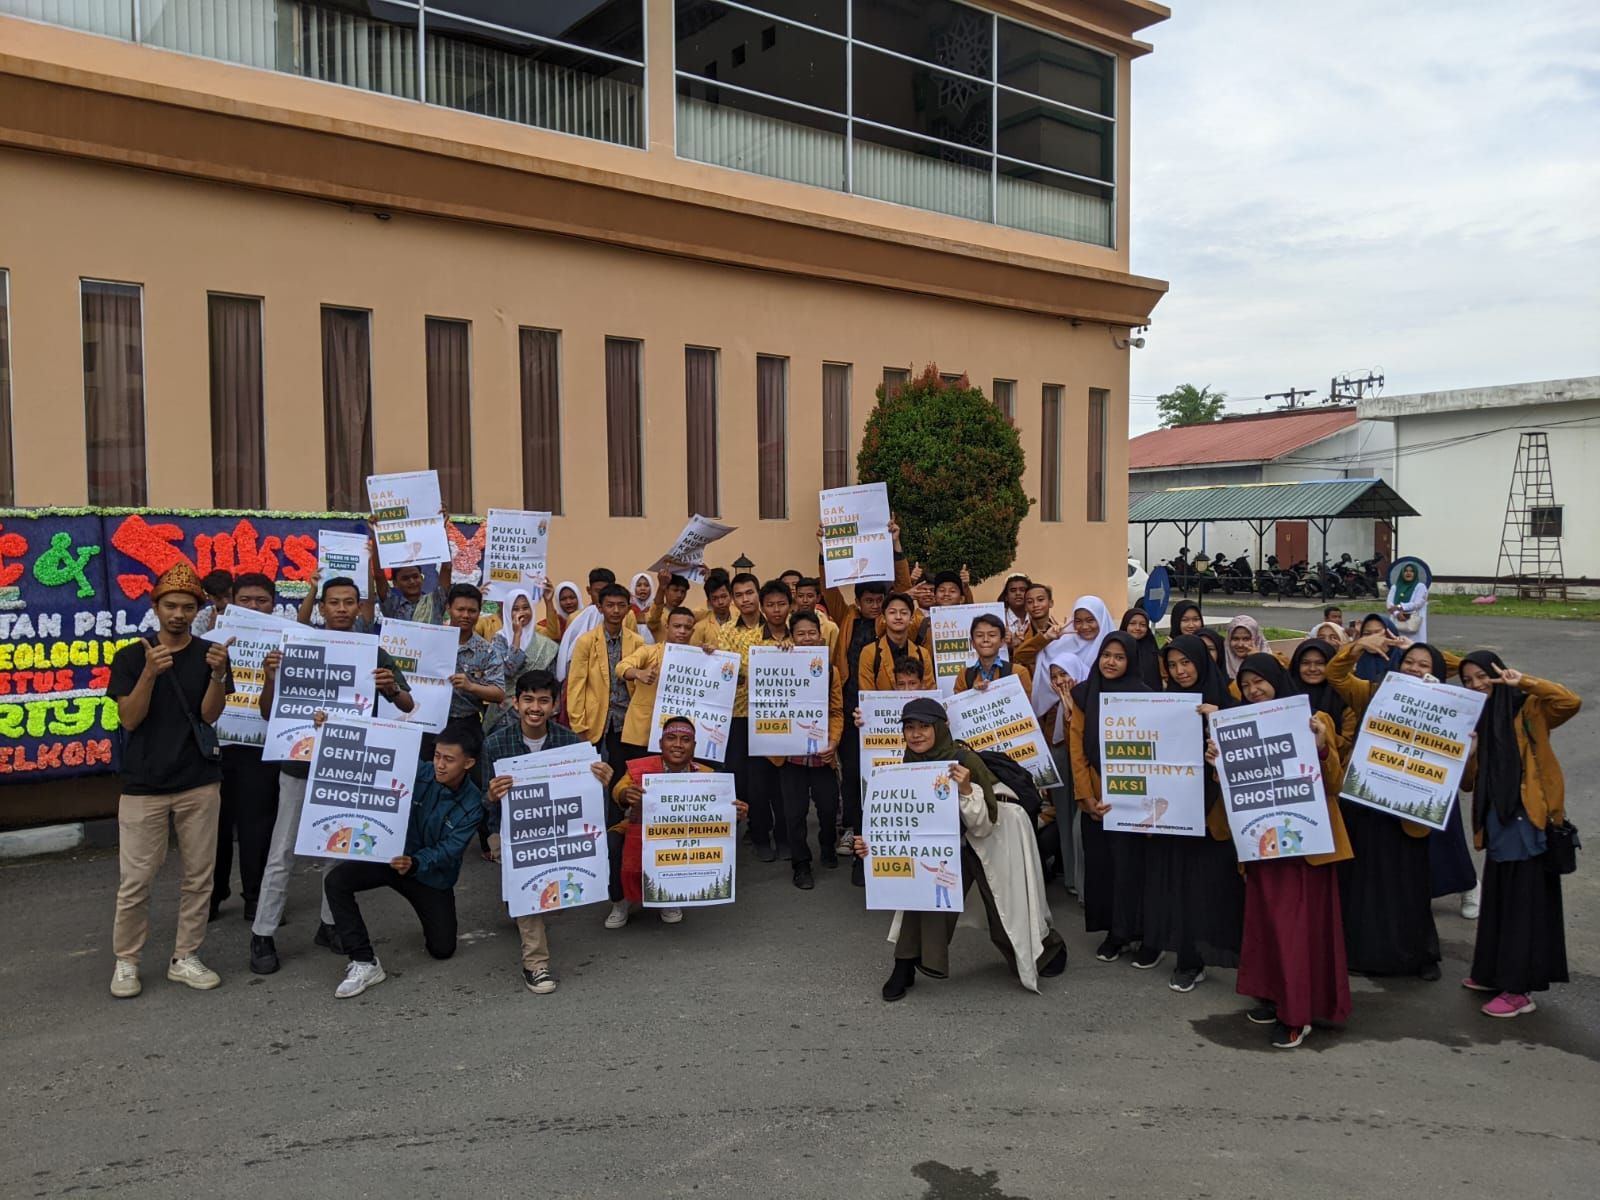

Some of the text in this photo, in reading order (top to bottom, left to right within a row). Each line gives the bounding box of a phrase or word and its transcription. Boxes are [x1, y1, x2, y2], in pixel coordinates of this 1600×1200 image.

[371, 490, 394, 499] GAK
[824, 506, 844, 515] GAK
[492, 527, 527, 535] PUKUL
[825, 527, 856, 536] JANJI
[380, 533, 403, 541] AKSI
[492, 536, 537, 544] MUNDUR
[491, 544, 527, 552] KRISIS
[828, 549, 851, 558] AKSI
[491, 553, 519, 561] IKLIM
[490, 561, 543, 570] SEKARANG
[491, 571, 518, 579] JUGA
[935, 621, 957, 629] GAK
[383, 635, 407, 645] GAK
[286, 648, 319, 659] IKLIM
[285, 667, 351, 681] GENTING
[669, 664, 707, 677] PUKUL
[755, 668, 796, 676] PUKUL
[667, 674, 720, 690] MUNDUR
[755, 679, 810, 687] MUNDUR
[283, 686, 336, 698] JANGAN
[665, 684, 705, 697] KRISIS
[755, 689, 796, 697] KRISIS
[663, 694, 696, 708] IKLIM
[755, 699, 788, 708] IKLIM
[661, 705, 727, 723] SEKARANG
[755, 710, 823, 719] SEKARANG
[757, 723, 788, 731] JUGA
[1105, 717, 1136, 727] GAK
[1379, 710, 1457, 740] LINGKUNGAN
[326, 728, 360, 741] IKLIM
[997, 721, 1032, 739] PILIHAN
[1104, 730, 1159, 740] BUTUH
[1220, 727, 1253, 742] IKLIM
[1369, 721, 1460, 755] BUKAN PILIHAN
[323, 747, 391, 765] GENTING
[1107, 746, 1152, 756] JANJI
[1225, 741, 1292, 762] GENTING
[1396, 743, 1424, 759] TAPI
[1106, 764, 1195, 776] BUTUHNYA
[1371, 750, 1444, 779] KEWAJIBAN
[318, 768, 373, 782] JANGAN
[1230, 765, 1282, 783] JANGAN
[1109, 780, 1143, 791] AKSI
[316, 788, 396, 807] GHOSTING
[511, 788, 544, 800] IKLIM
[872, 789, 917, 800] PUKUL
[1234, 784, 1310, 805] GHOSTING
[513, 803, 578, 820] GENTING
[871, 802, 935, 813] MUNDUR
[654, 815, 722, 823] LINGKUNGAN
[871, 816, 918, 828] KRISIS
[513, 825, 565, 840] JANGAN
[648, 826, 728, 836] BUKAN PILIHAN
[870, 830, 910, 842] IKLIM
[516, 841, 592, 862] GHOSTING
[658, 851, 720, 861] KEWAJIBAN
[871, 845, 953, 857] SEKARANG
[874, 862, 911, 872] JUGA
